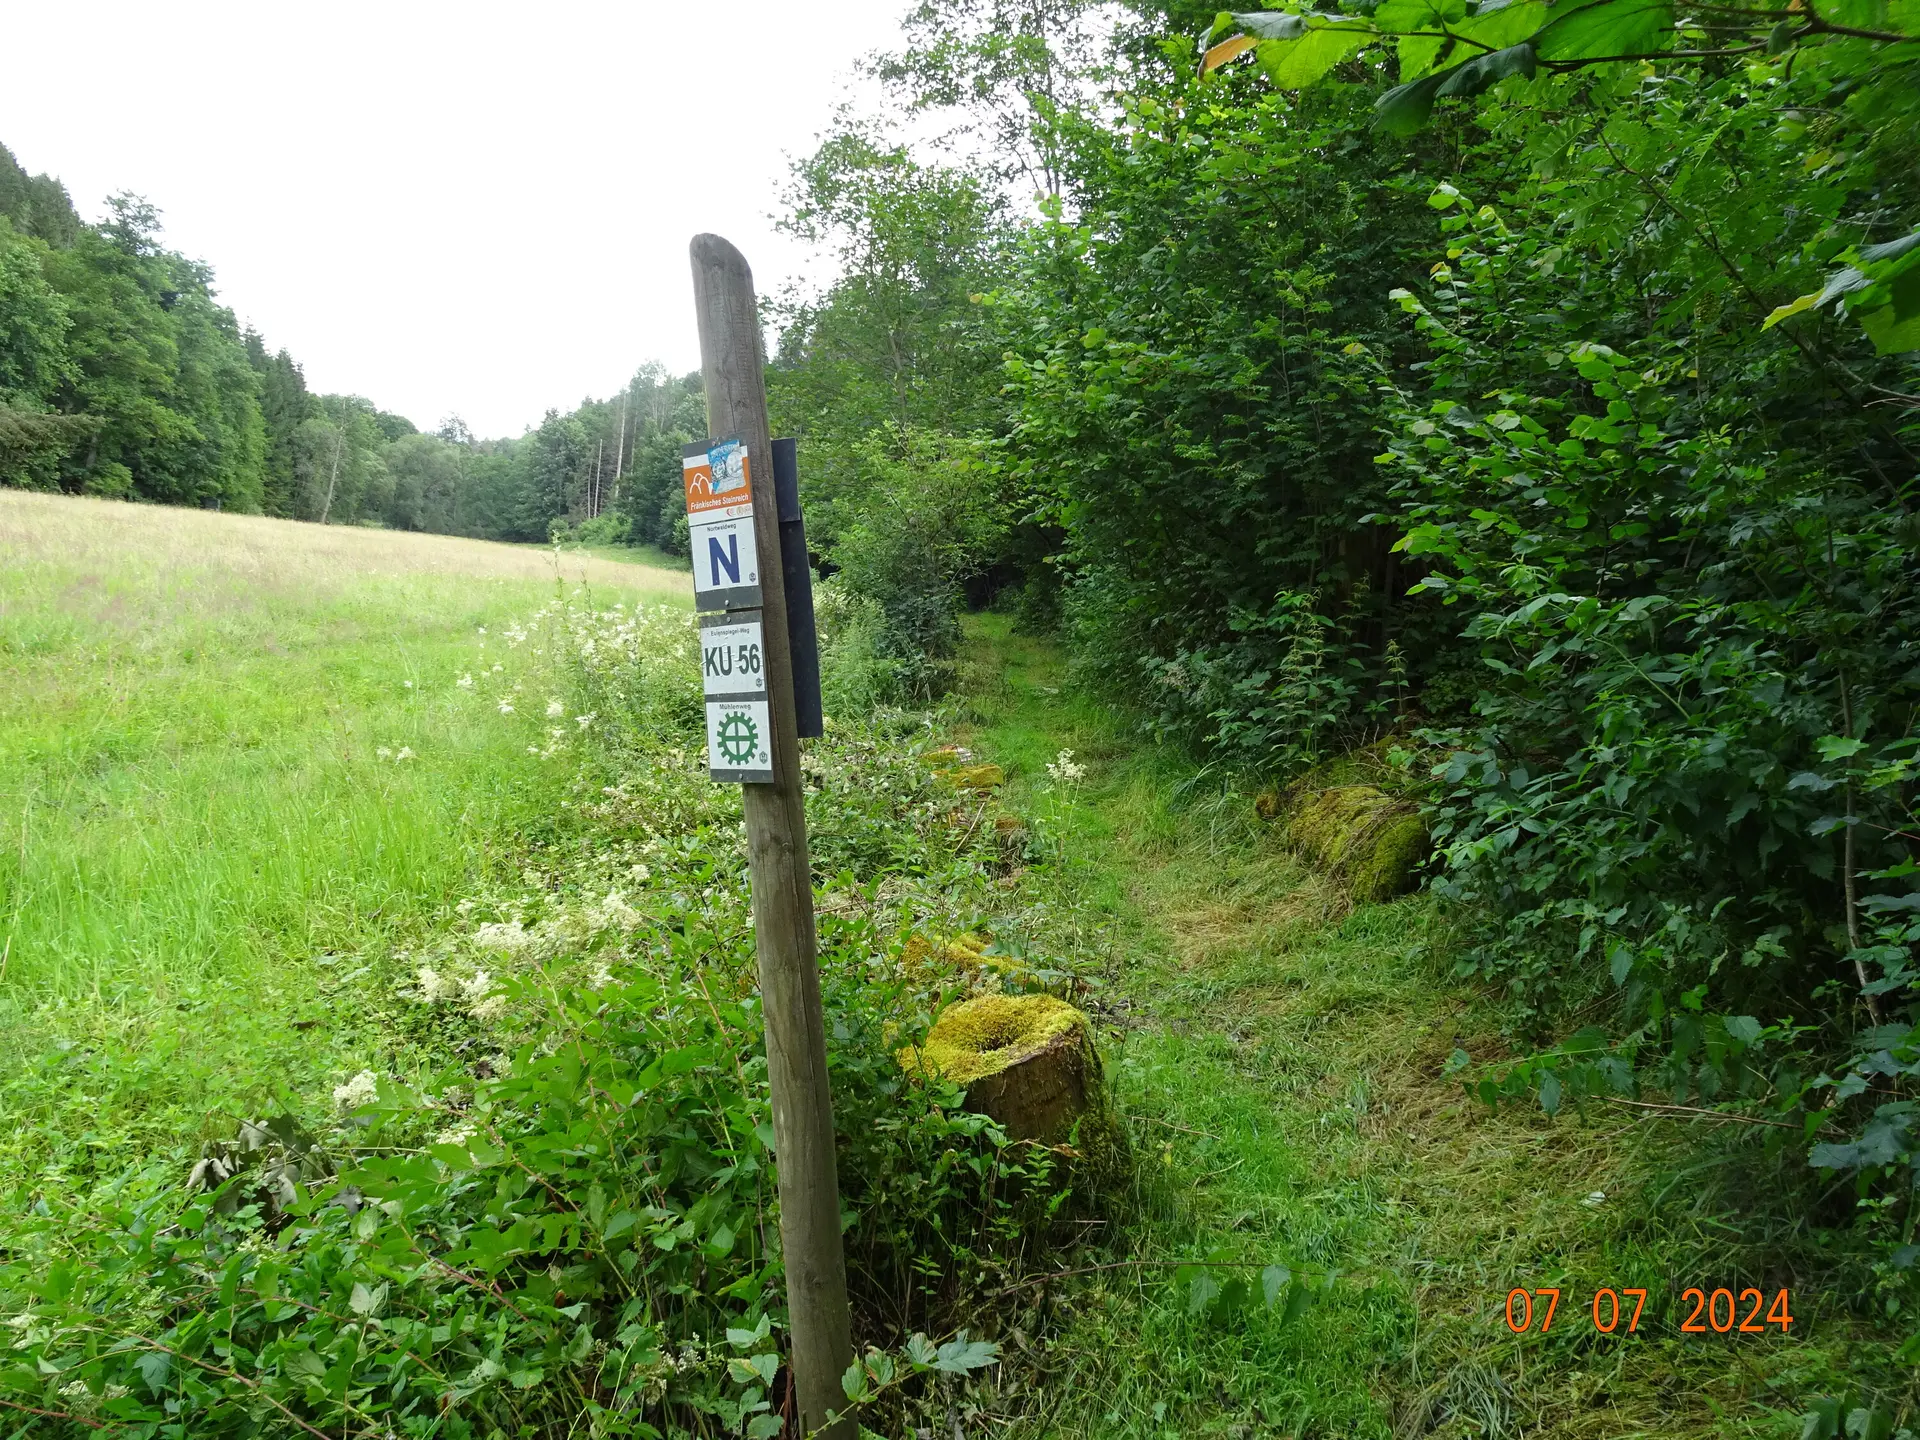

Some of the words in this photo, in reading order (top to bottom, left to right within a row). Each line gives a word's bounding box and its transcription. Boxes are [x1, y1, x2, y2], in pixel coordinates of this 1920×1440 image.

[690, 498, 721, 511] Fränkisches
[722, 493, 749, 505] Steinreich
[708, 533, 740, 586] N
[704, 646, 732, 677] KU
[739, 643, 760, 675] 56
